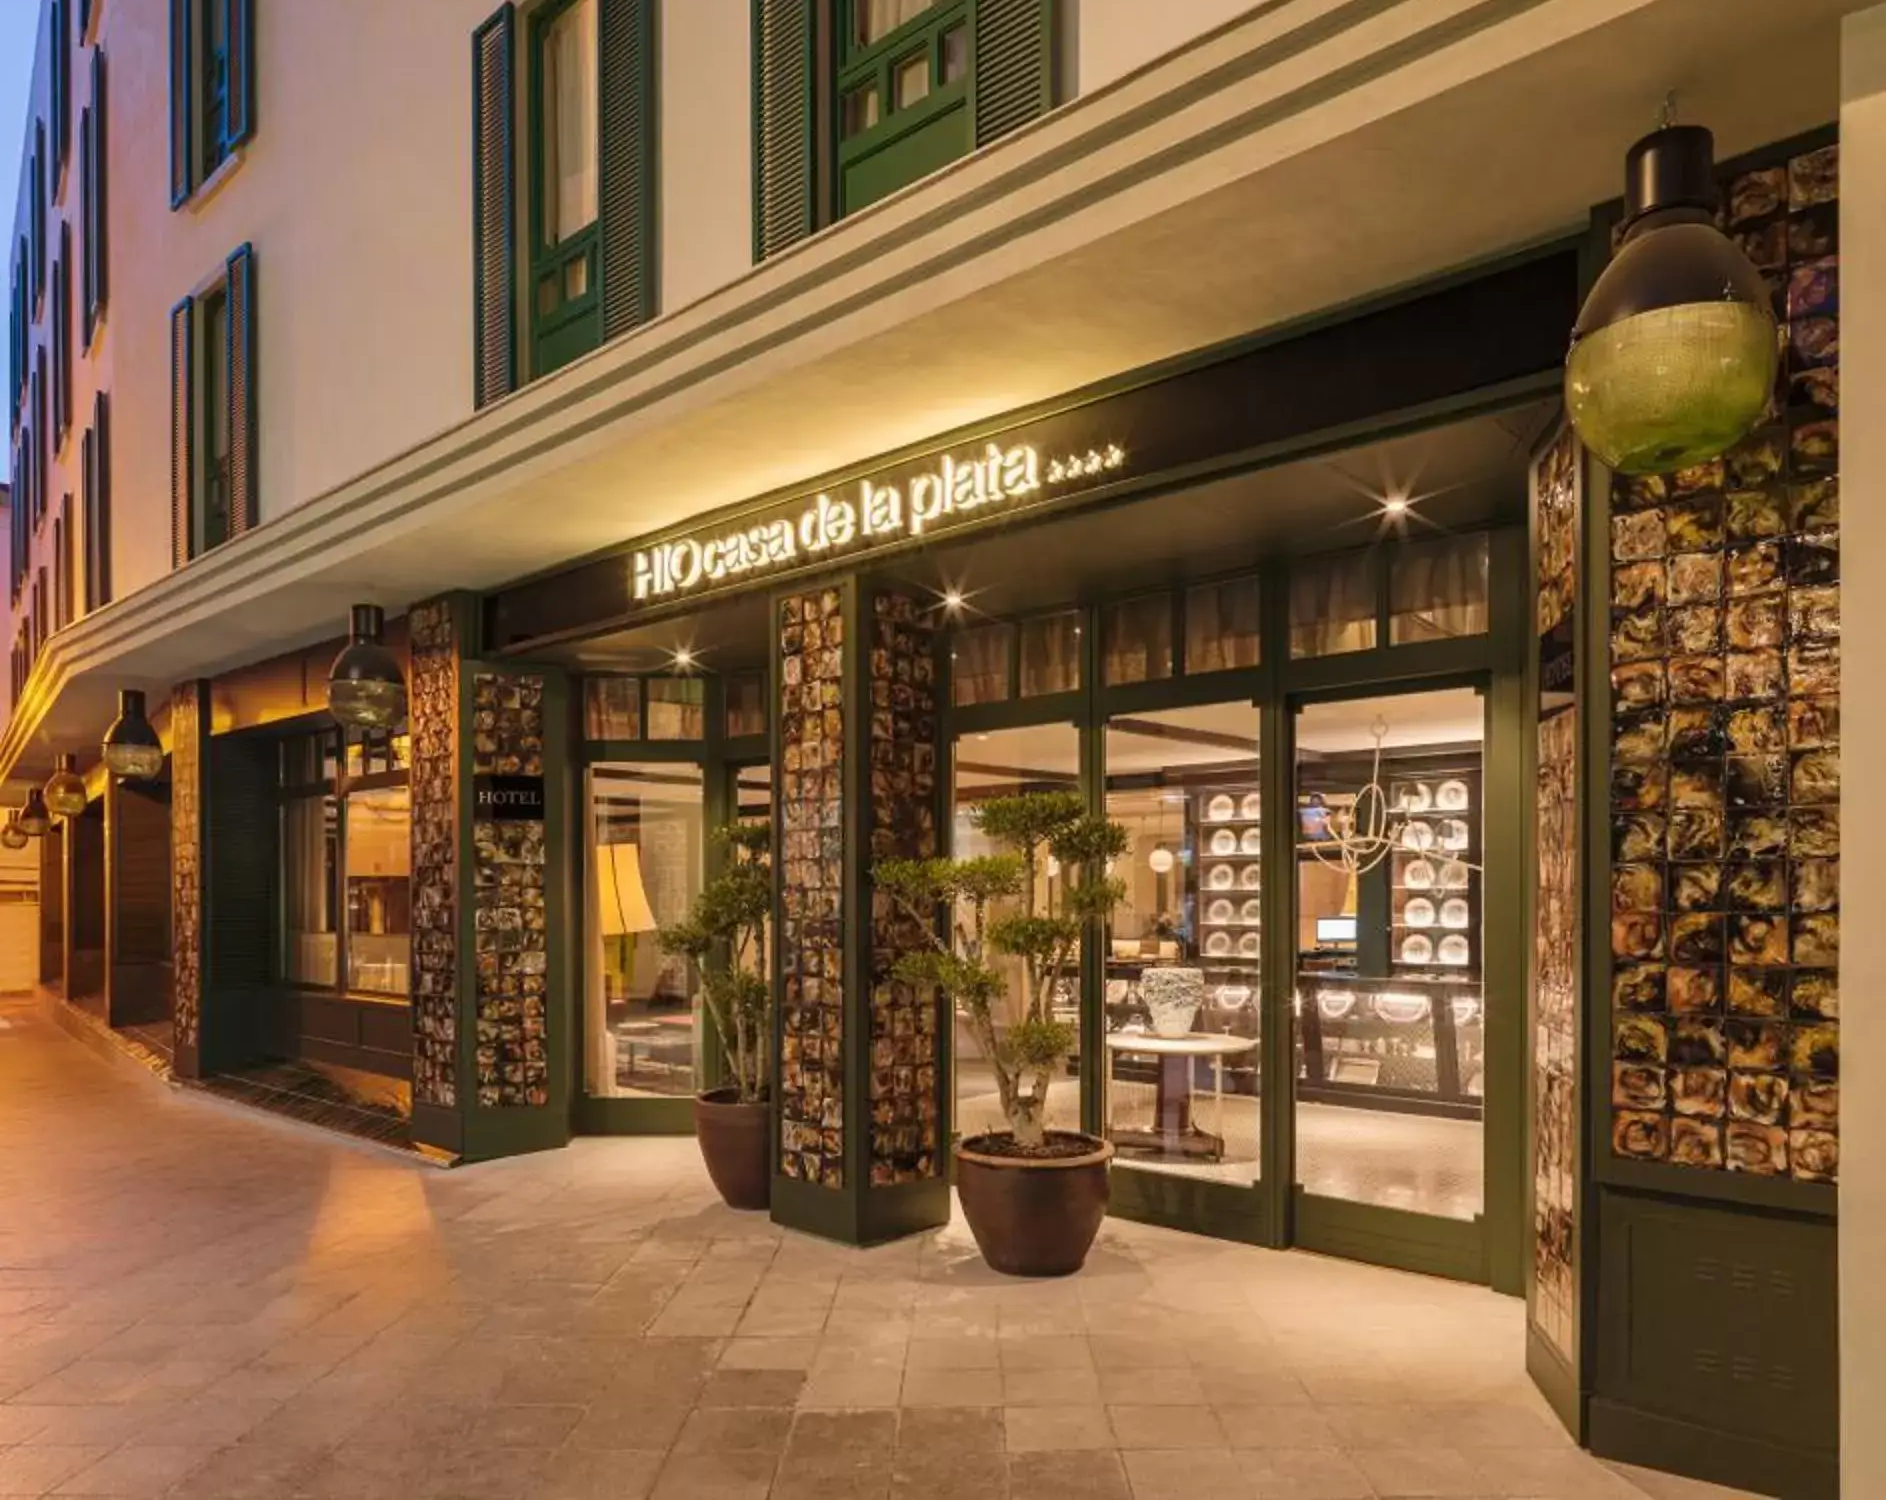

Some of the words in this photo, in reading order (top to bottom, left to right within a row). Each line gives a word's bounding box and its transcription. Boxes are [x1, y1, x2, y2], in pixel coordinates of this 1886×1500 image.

[703, 519, 796, 579] casa
[800, 494, 856, 551] de
[861, 480, 903, 536] la
[909, 443, 1040, 535] plata
[479, 791, 541, 805] HOTEL
